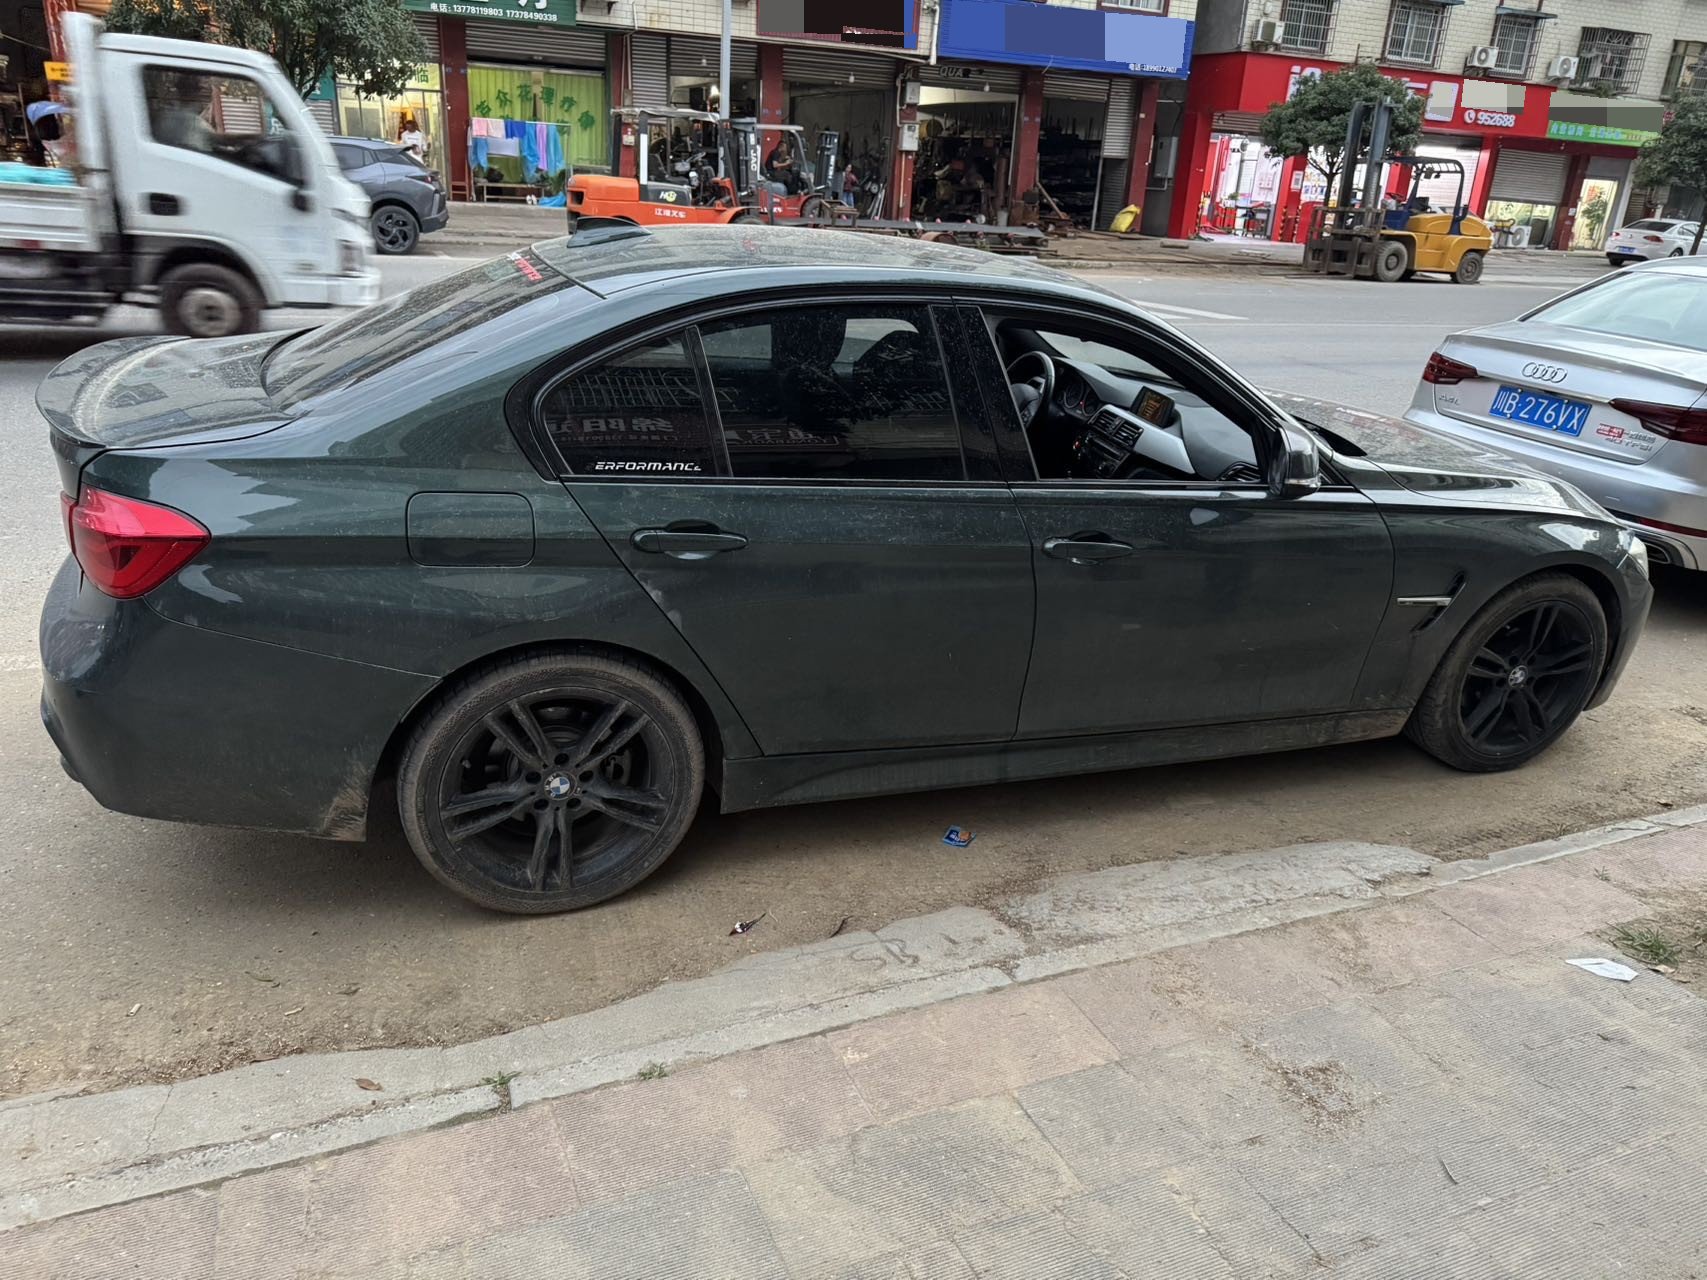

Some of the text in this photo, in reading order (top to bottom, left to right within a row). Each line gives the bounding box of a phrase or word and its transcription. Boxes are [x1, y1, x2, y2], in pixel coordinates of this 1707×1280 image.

[453, 4, 503, 16] 13778119803
[506, 9, 558, 21] 17378490338
[1477, 111, 1515, 127] 952688
